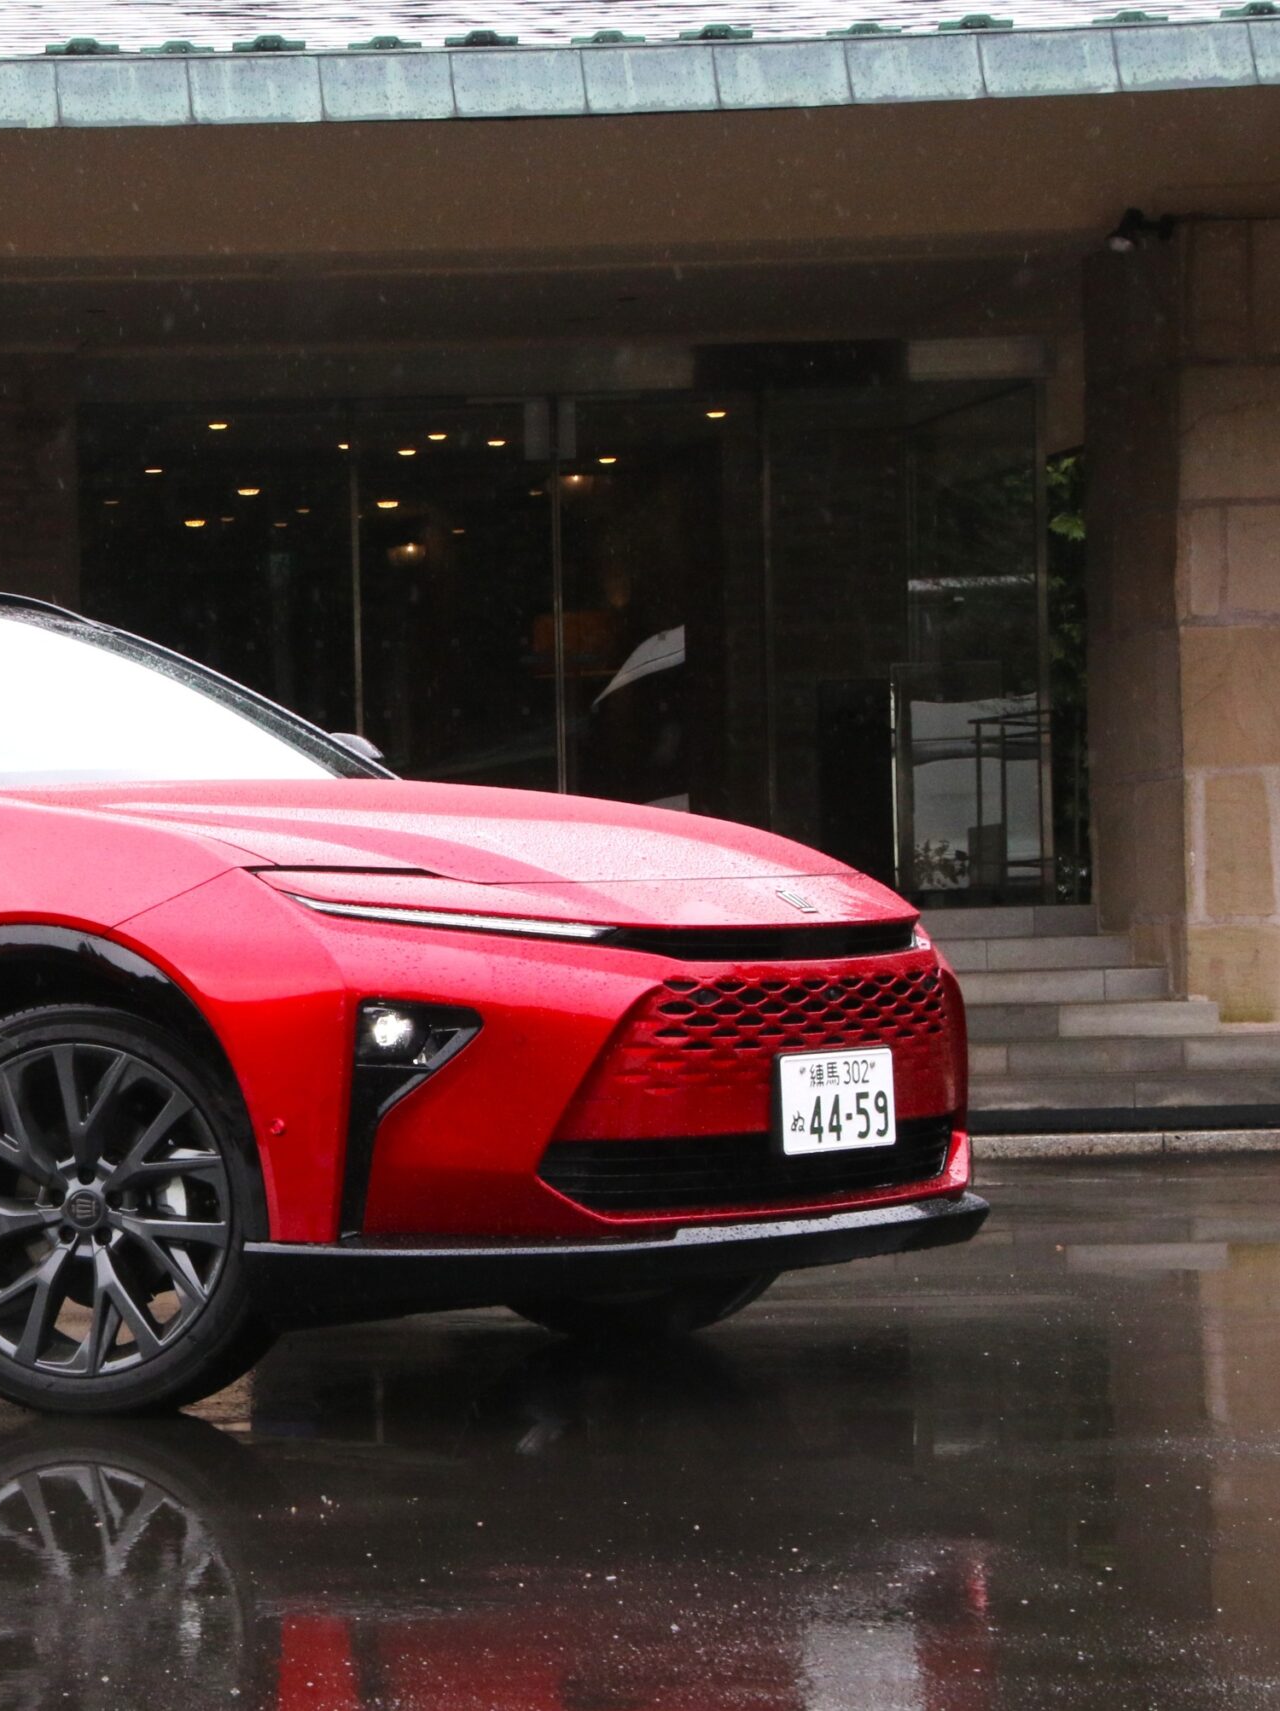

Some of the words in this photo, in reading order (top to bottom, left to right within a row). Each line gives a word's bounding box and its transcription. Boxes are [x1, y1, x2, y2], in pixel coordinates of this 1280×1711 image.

[809, 1061, 840, 1087] 練馬
[843, 1059, 870, 1085] 302
[790, 1110, 805, 1132] ぬ
[809, 1090, 889, 1144] 44-59
